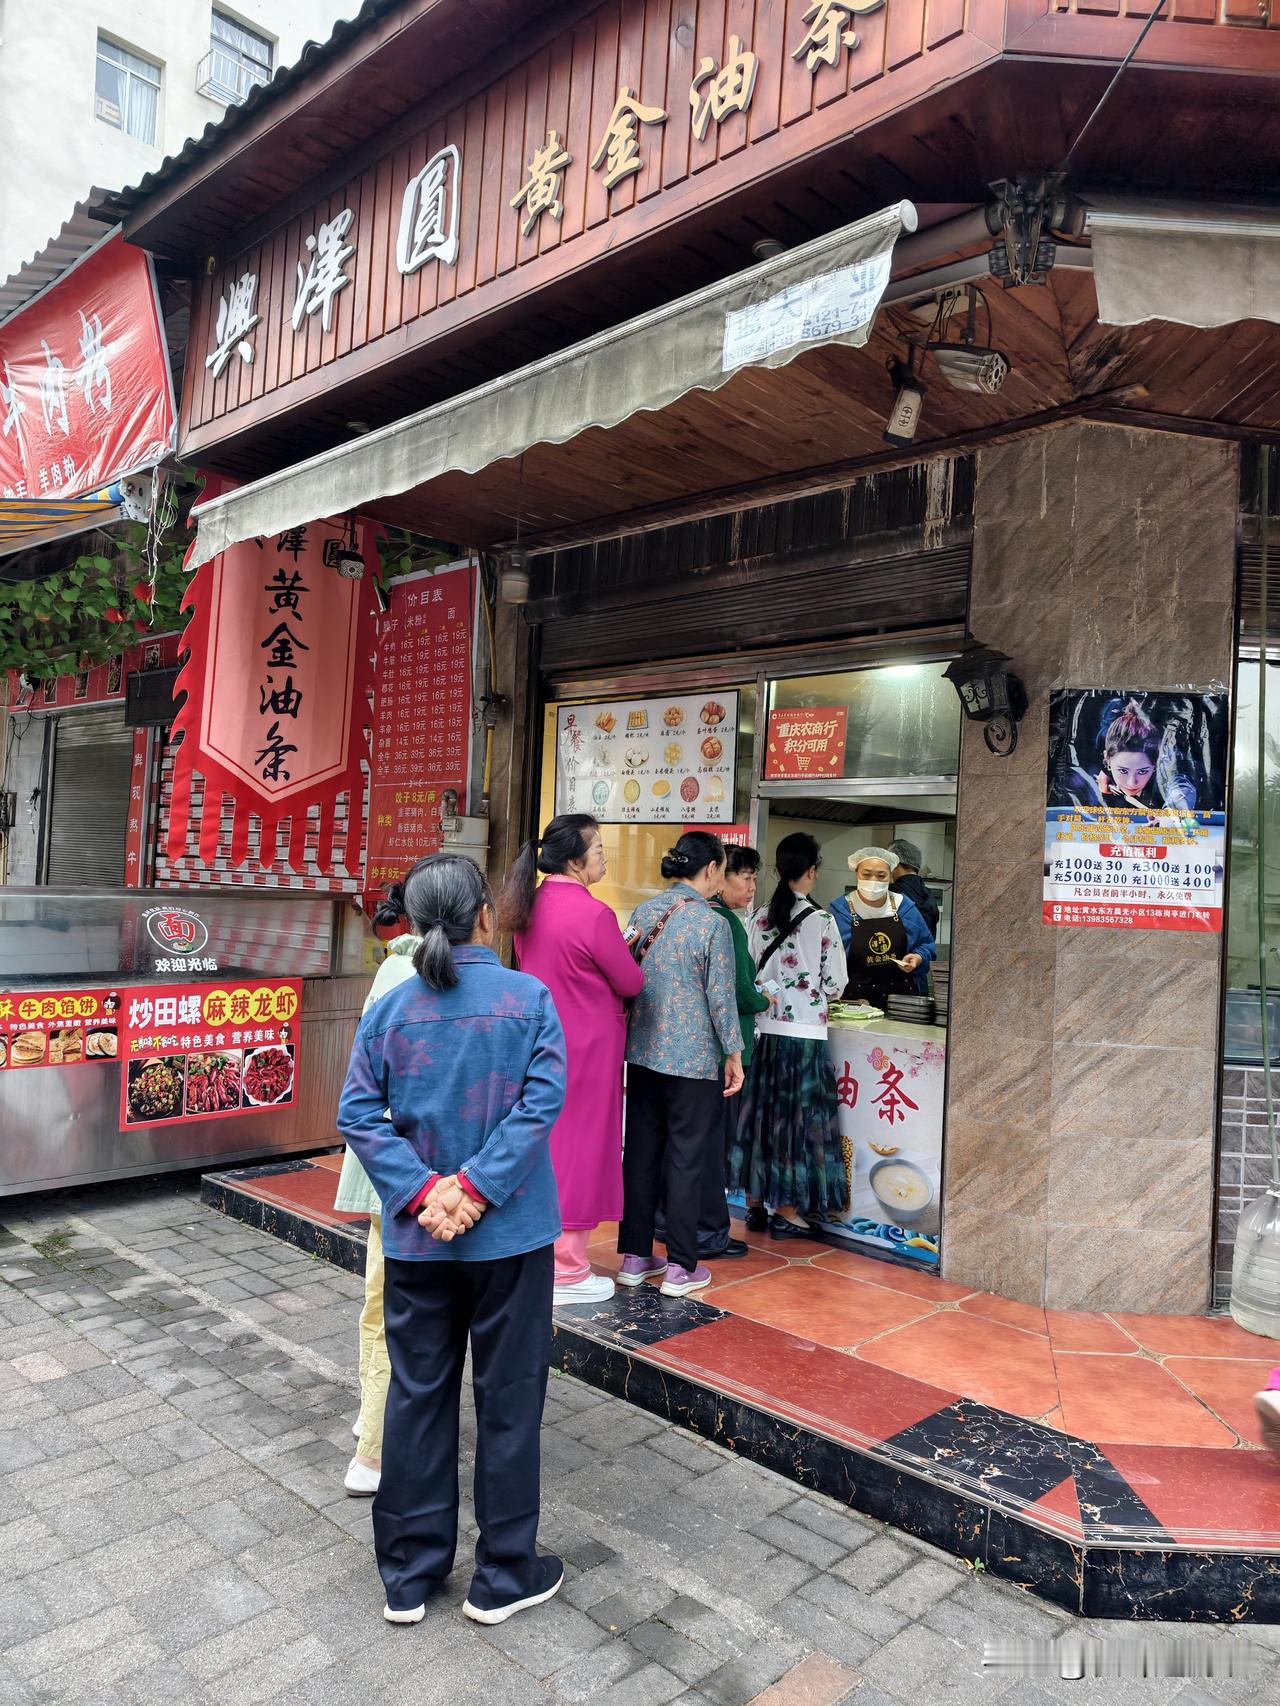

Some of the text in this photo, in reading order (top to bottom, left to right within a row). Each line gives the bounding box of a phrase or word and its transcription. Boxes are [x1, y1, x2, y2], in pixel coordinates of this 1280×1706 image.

[406, 589, 444, 607] 价目表
[406, 614, 422, 627] 米粉
[447, 607, 456, 620] 面
[401, 639, 414, 649] 16元
[417, 636, 430, 646] 19元
[435, 632, 448, 643] 16元
[453, 629, 467, 639] 19元
[400, 654, 413, 662] 16元
[417, 650, 430, 660] 19元
[434, 647, 448, 656] 16元
[452, 644, 466, 654] 19元
[255, 568, 311, 782] 黄金油条
[400, 667, 412, 676] 16元
[416, 664, 429, 674] 19元
[434, 662, 447, 671] 16元
[451, 659, 465, 668] 19元
[399, 681, 411, 690] 16元
[416, 678, 428, 688] 19元
[433, 676, 446, 686] 16元
[451, 673, 464, 683] 19元
[398, 695, 411, 704] 16元
[415, 692, 427, 702] 19元
[432, 690, 445, 700] 16元
[450, 688, 463, 697] 19元
[380, 702, 463, 719] 羊肉 16元 19元 16元 19元
[397, 722, 409, 732] 16元
[413, 720, 426, 730] 19元
[431, 719, 444, 729] 16元
[449, 717, 462, 727] 19元
[776, 720, 838, 738] 重庆农商行
[396, 737, 408, 746] 14元
[412, 734, 426, 744] 16元
[430, 733, 444, 743] 14元
[448, 731, 462, 741] 16元
[784, 738, 828, 754] 积分可用
[395, 751, 408, 759] 36元
[411, 749, 425, 758] 39元
[429, 748, 443, 757] 36元
[446, 746, 461, 756] 39元
[394, 764, 407, 774] 36元
[410, 763, 424, 772] 39元
[428, 762, 442, 772] 36元
[446, 761, 460, 770] 39元
[378, 815, 392, 826] 种类
[1110, 845, 1157, 858] 充值福利
[158, 911, 196, 943] 面
[155, 957, 218, 973] 欢迎光临
[21, 998, 94, 1017] 牛肉馅饼
[128, 991, 296, 1030] 炒田螺 麻辣龙虾
[180, 1032, 226, 1050] 特色美食
[231, 1029, 275, 1045] 营养美味
